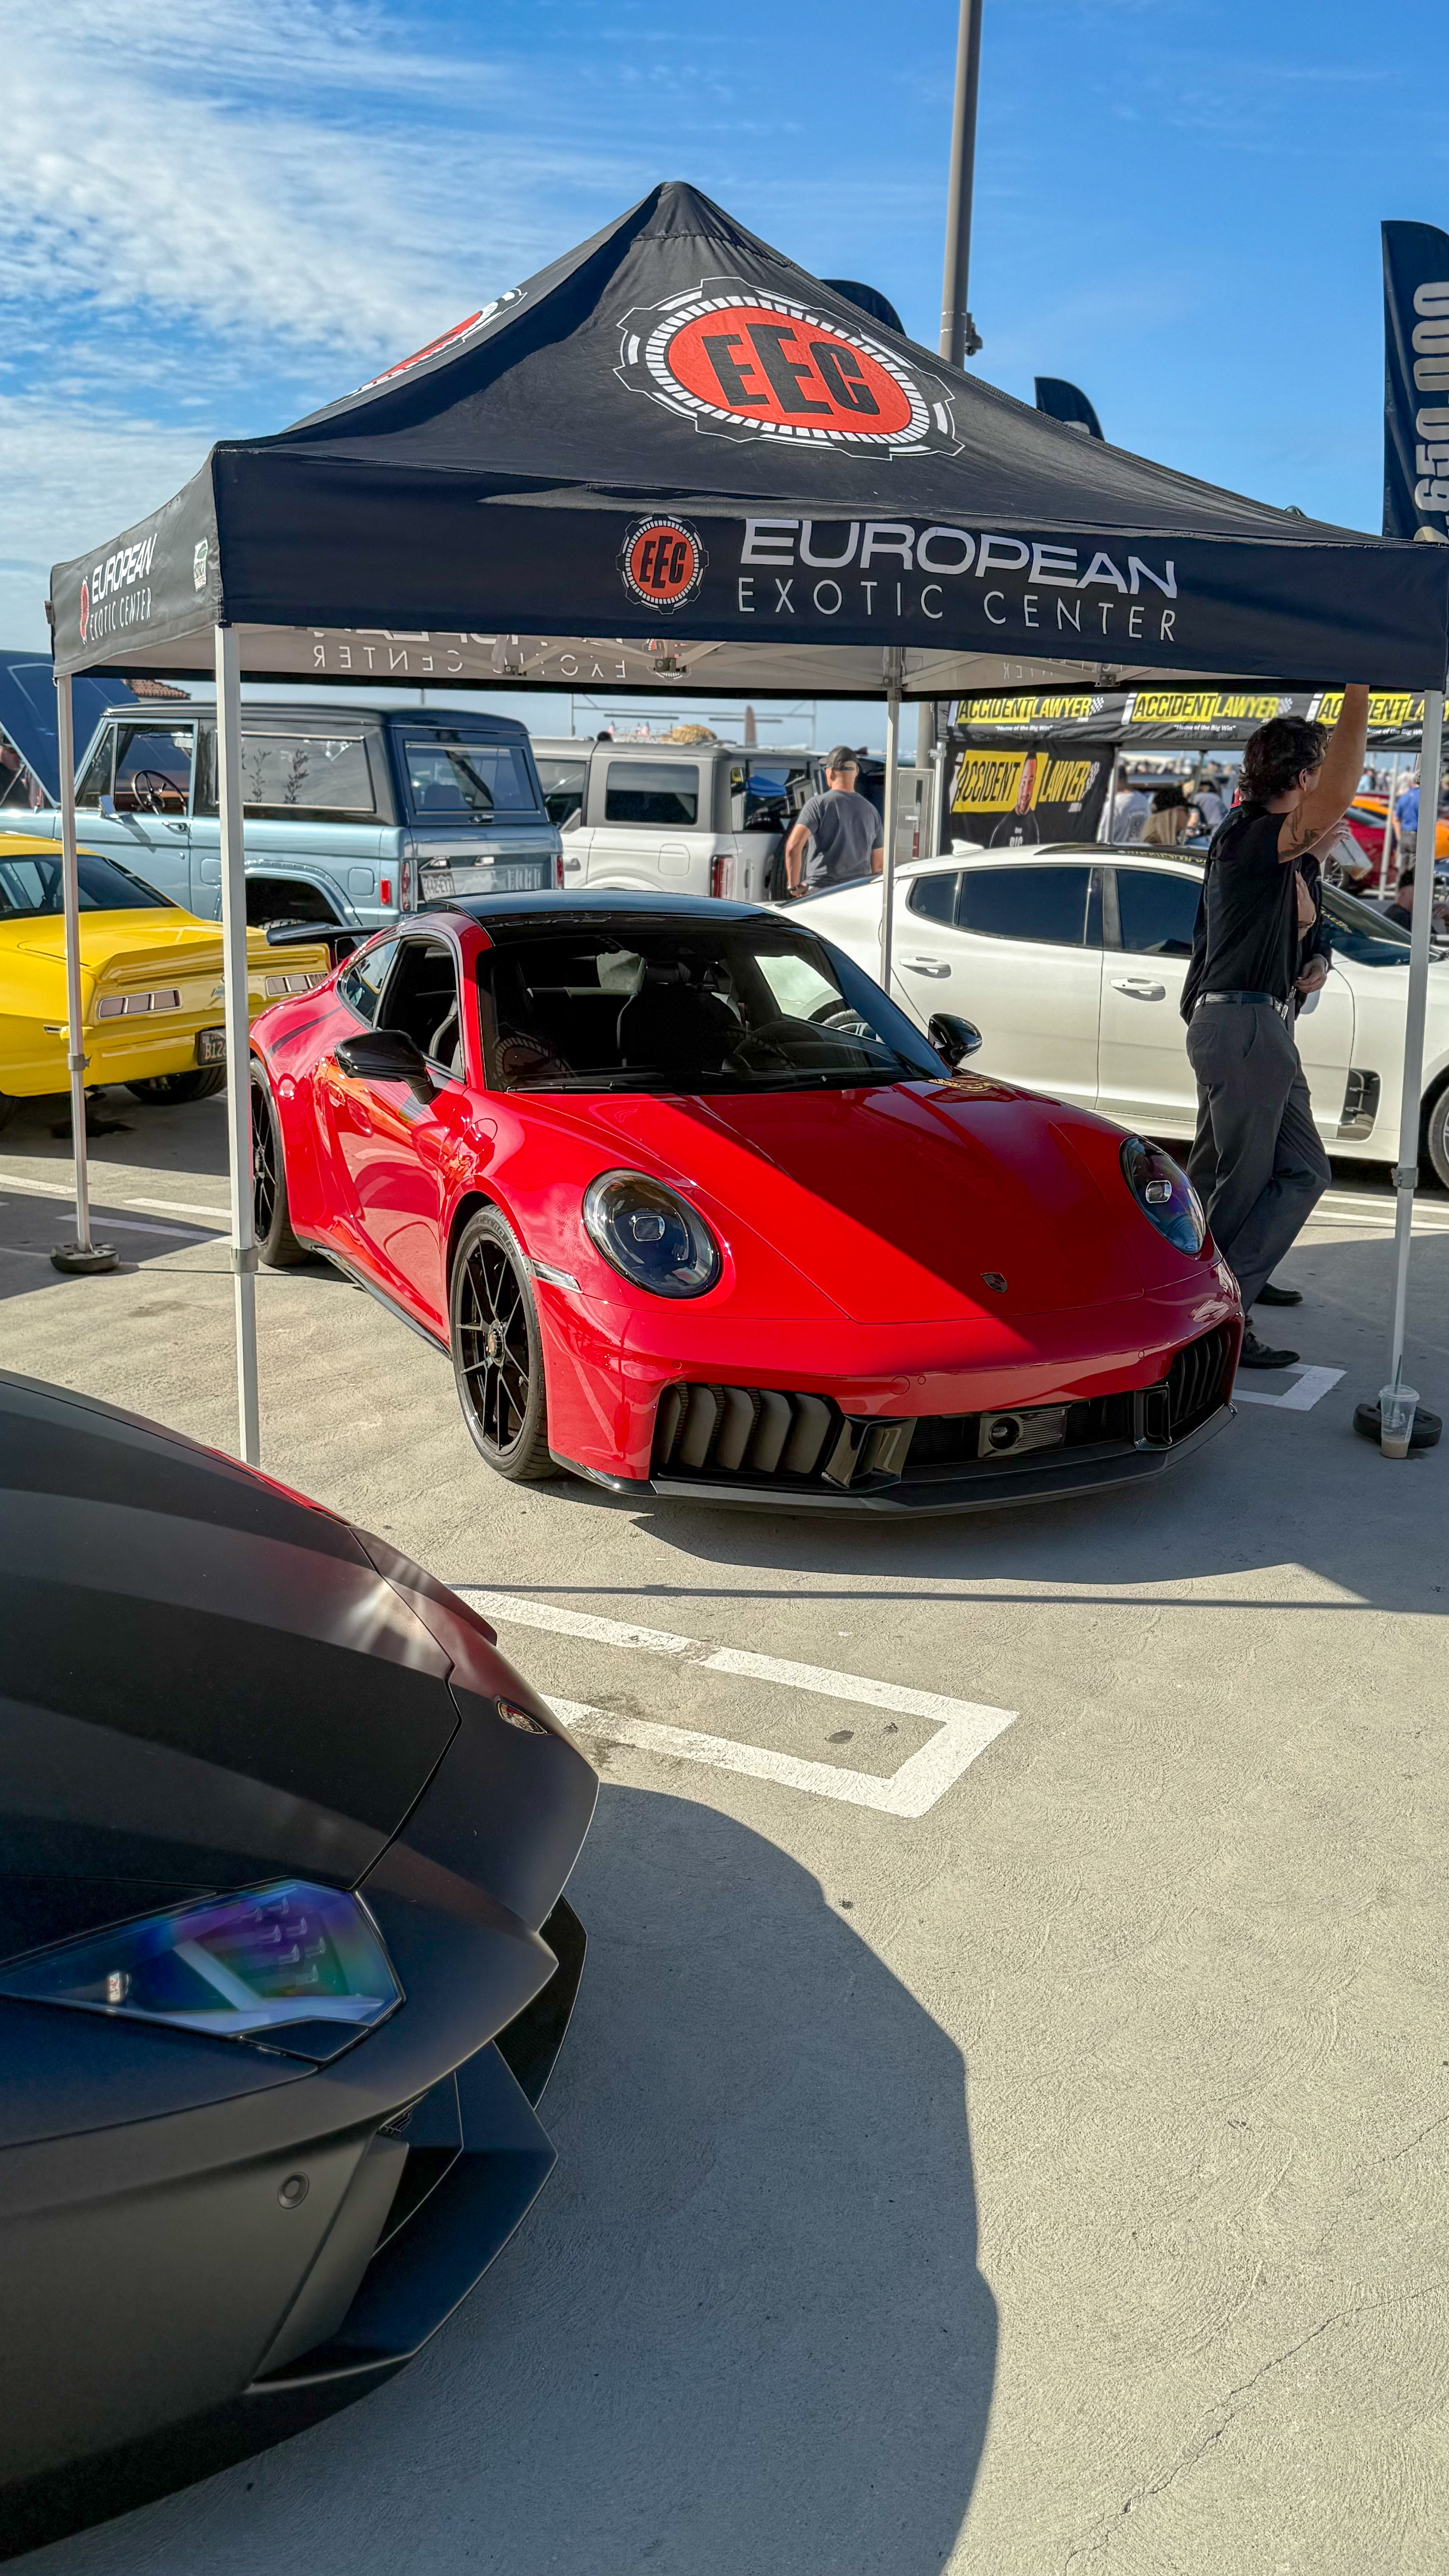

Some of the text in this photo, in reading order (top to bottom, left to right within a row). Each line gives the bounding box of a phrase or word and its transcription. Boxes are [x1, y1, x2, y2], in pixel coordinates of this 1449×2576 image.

[701, 323, 880, 415] EEC
[92, 533, 158, 604] EUROPEAN
[639, 536, 687, 589] EEC
[740, 518, 1177, 599] EUROPEAN
[90, 587, 151, 641] EXOTIC CENTER
[738, 577, 1176, 642] EXOTIC CENTER
[1038, 760, 1092, 802] LAWYER
